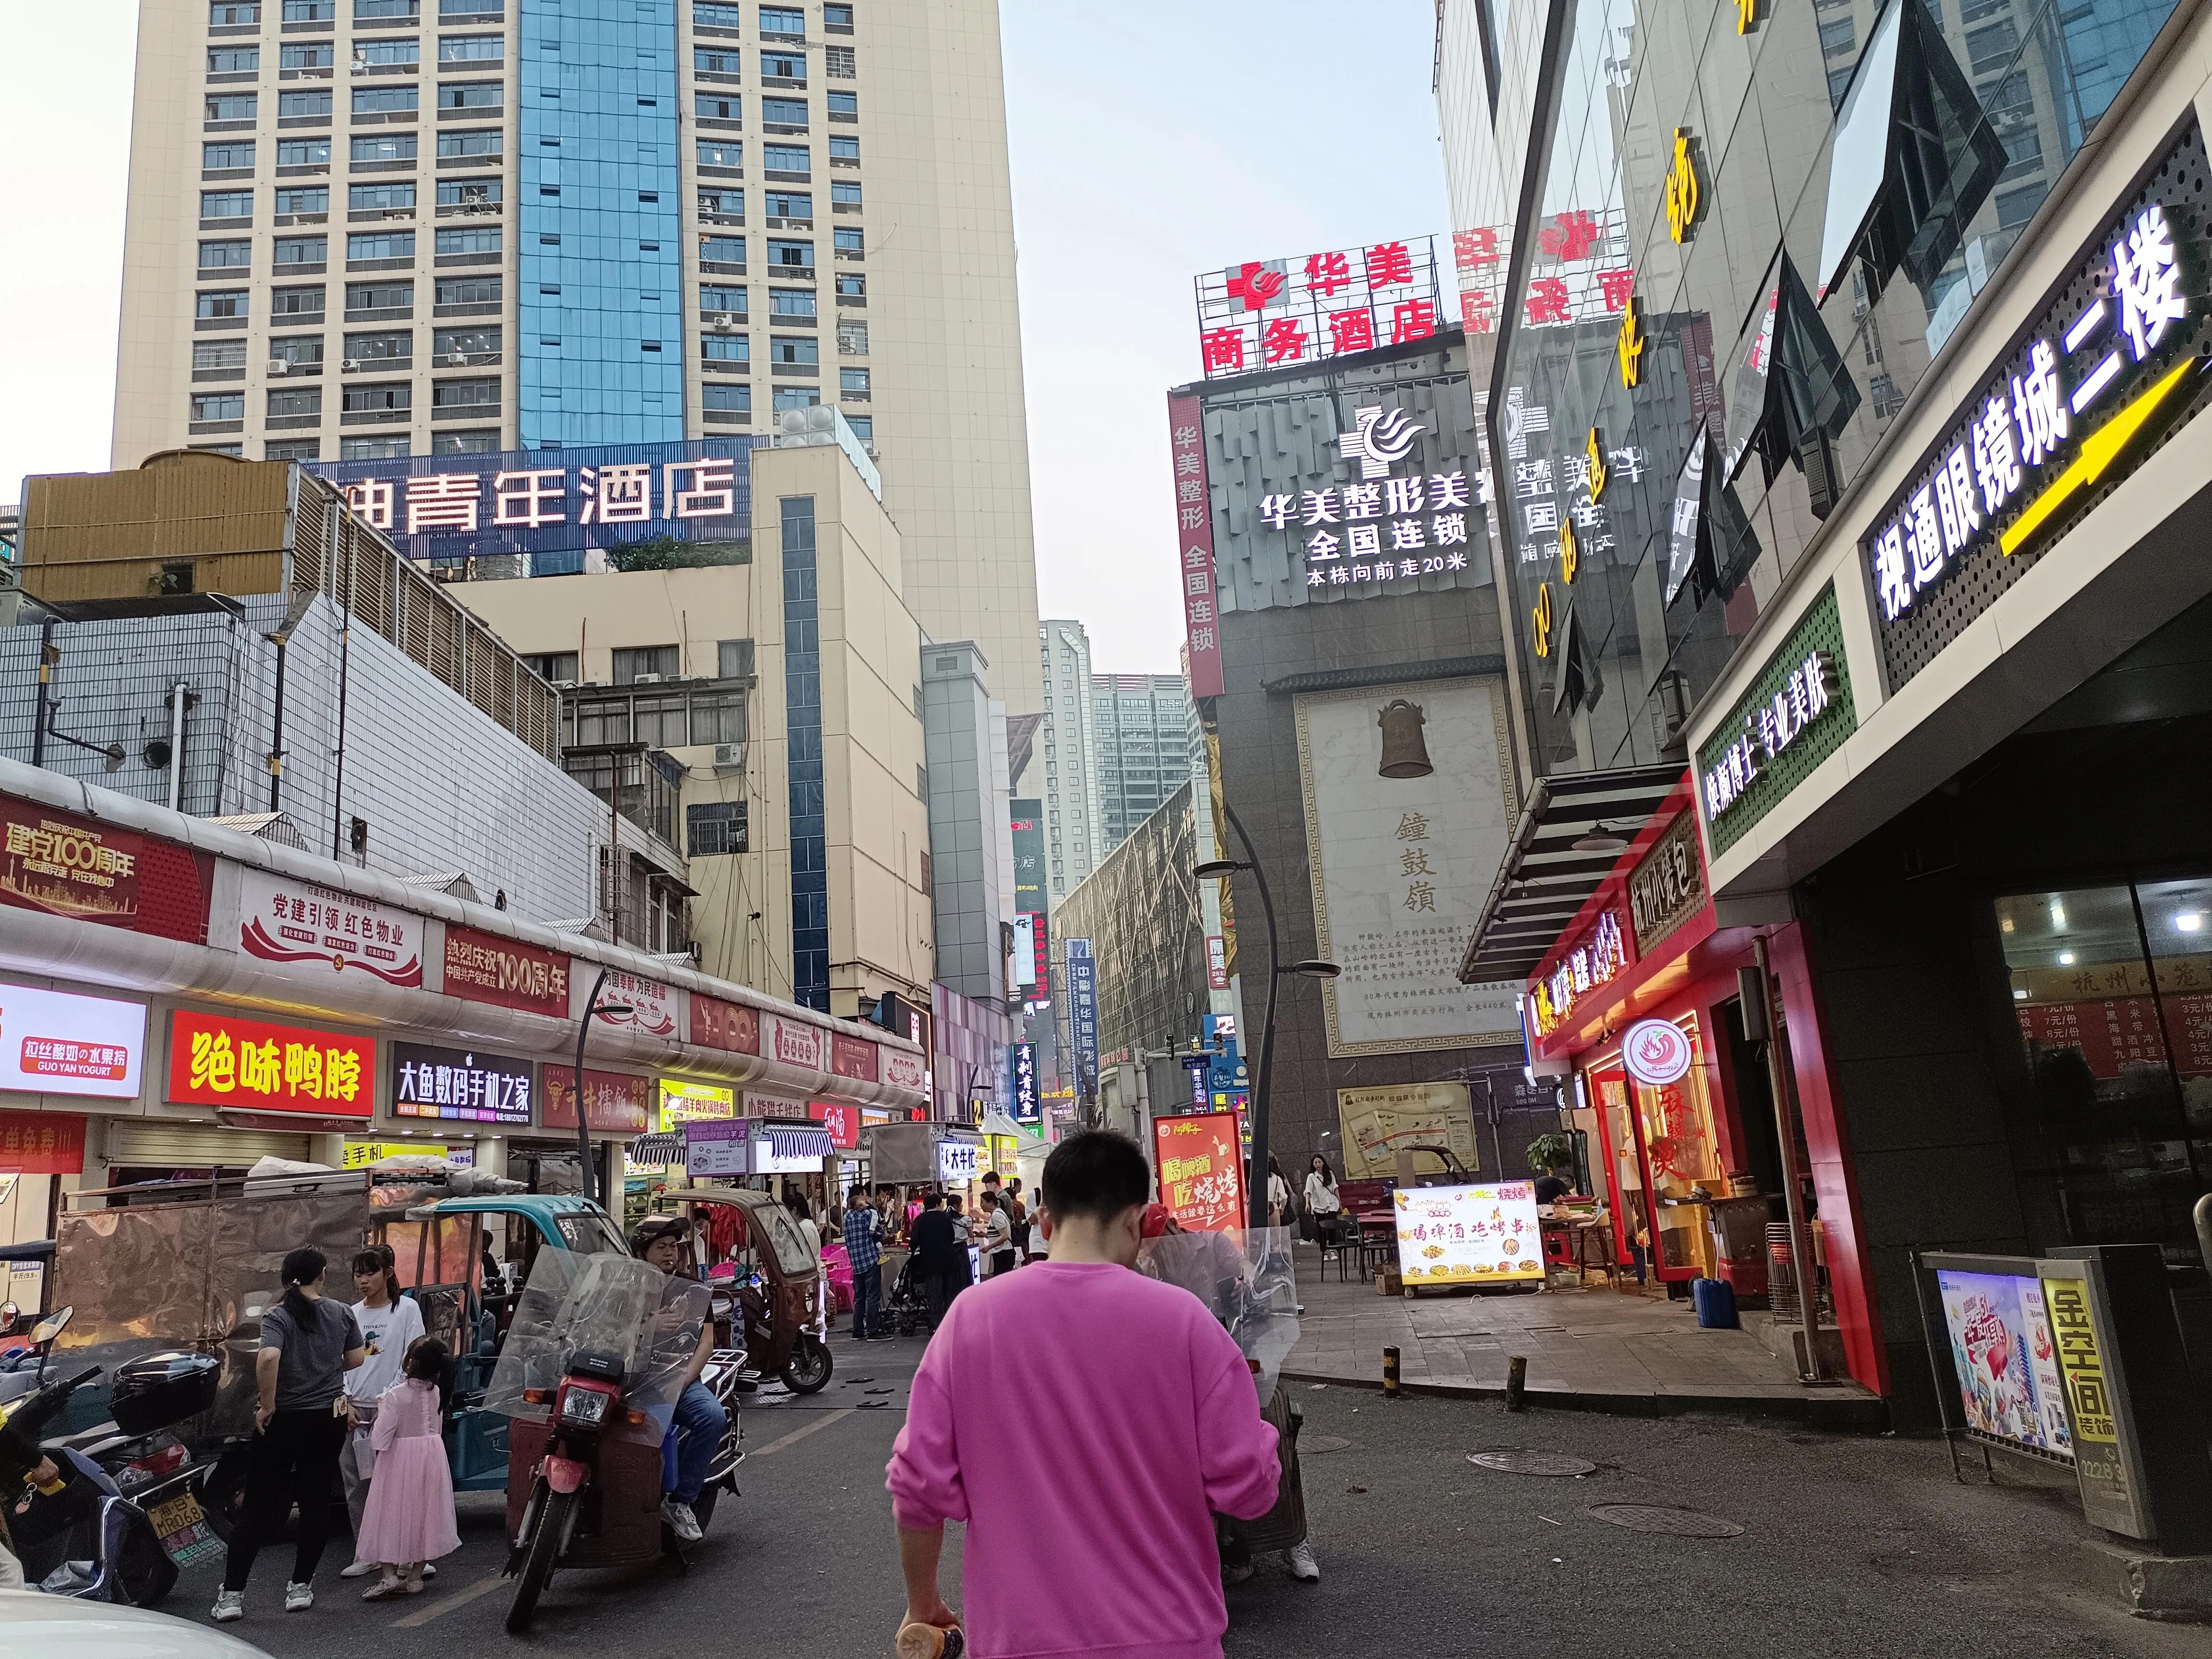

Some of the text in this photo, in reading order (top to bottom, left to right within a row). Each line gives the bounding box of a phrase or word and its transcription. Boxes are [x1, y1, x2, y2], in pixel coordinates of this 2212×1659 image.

[1304, 240, 1413, 296] 华美
[1201, 299, 1435, 372] 商务酒店
[1875, 205, 2185, 622] 视通眼镜城二楼
[1174, 426, 1215, 653] 华美整形 全国连锁
[1308, 513, 1467, 561] 全国连锁
[1307, 552, 1467, 587] 本栋向前走20米
[5, 822, 135, 877] 建党100周年
[1395, 812, 1437, 913] 鐘鼓嶺
[23, 857, 114, 888] 永远跟党走 党在我心中
[307, 886, 342, 903] 打造红色物业
[273, 893, 403, 946] 党建引领 红色物业
[447, 938, 496, 972] 热烈庆祝
[446, 966, 496, 988] 中国共产党成立
[497, 950, 566, 1002] 100周年
[637, 979, 665, 1000] 为民造福
[25, 1040, 126, 1066] 拉丝酸奶の水果捞
[38, 1061, 111, 1076] GUO YAN YOGURT
[190, 1029, 361, 1102] 绝味鸭脖
[398, 1061, 529, 1111] 大鱼数码手机之家
[1162, 1153, 1211, 1185] 喝啤酒
[1173, 1165, 1238, 1208] 吃烧烤
[1172, 1201, 1236, 1219] 生活就要这么爽
[1497, 1187, 1527, 1201] 烧烤
[1414, 1218, 1524, 1241] 喝啤酒 吃烤串
[2079, 1416, 2114, 1435] 装饰
